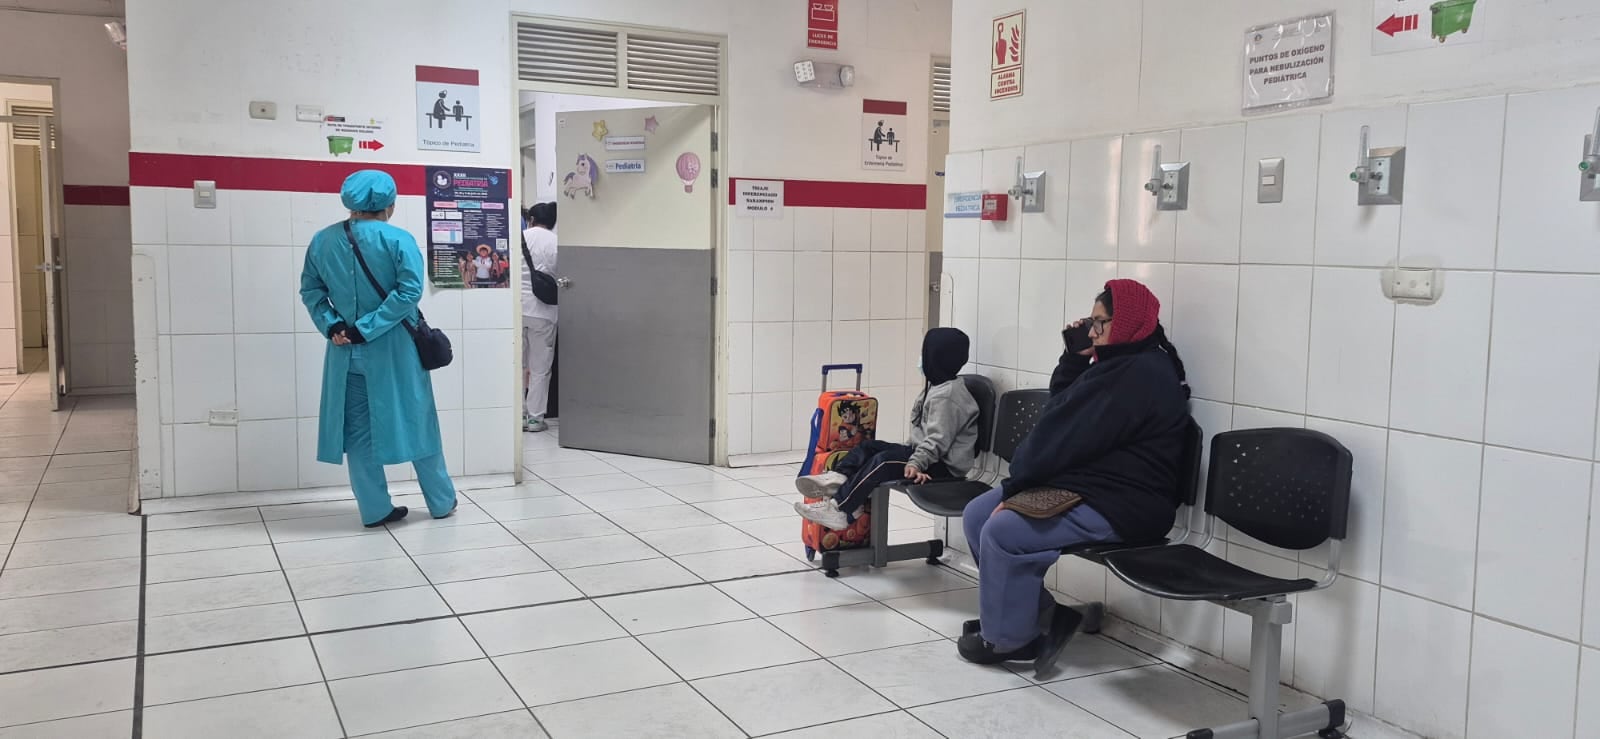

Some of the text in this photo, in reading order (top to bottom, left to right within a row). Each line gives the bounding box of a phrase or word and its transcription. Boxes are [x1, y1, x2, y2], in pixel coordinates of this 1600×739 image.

[1249, 53, 1278, 64] PUNTOS
[1291, 44, 1325, 56] OXÍGENO
[1249, 56, 1324, 75] PARA NEBULIZACIÓN
